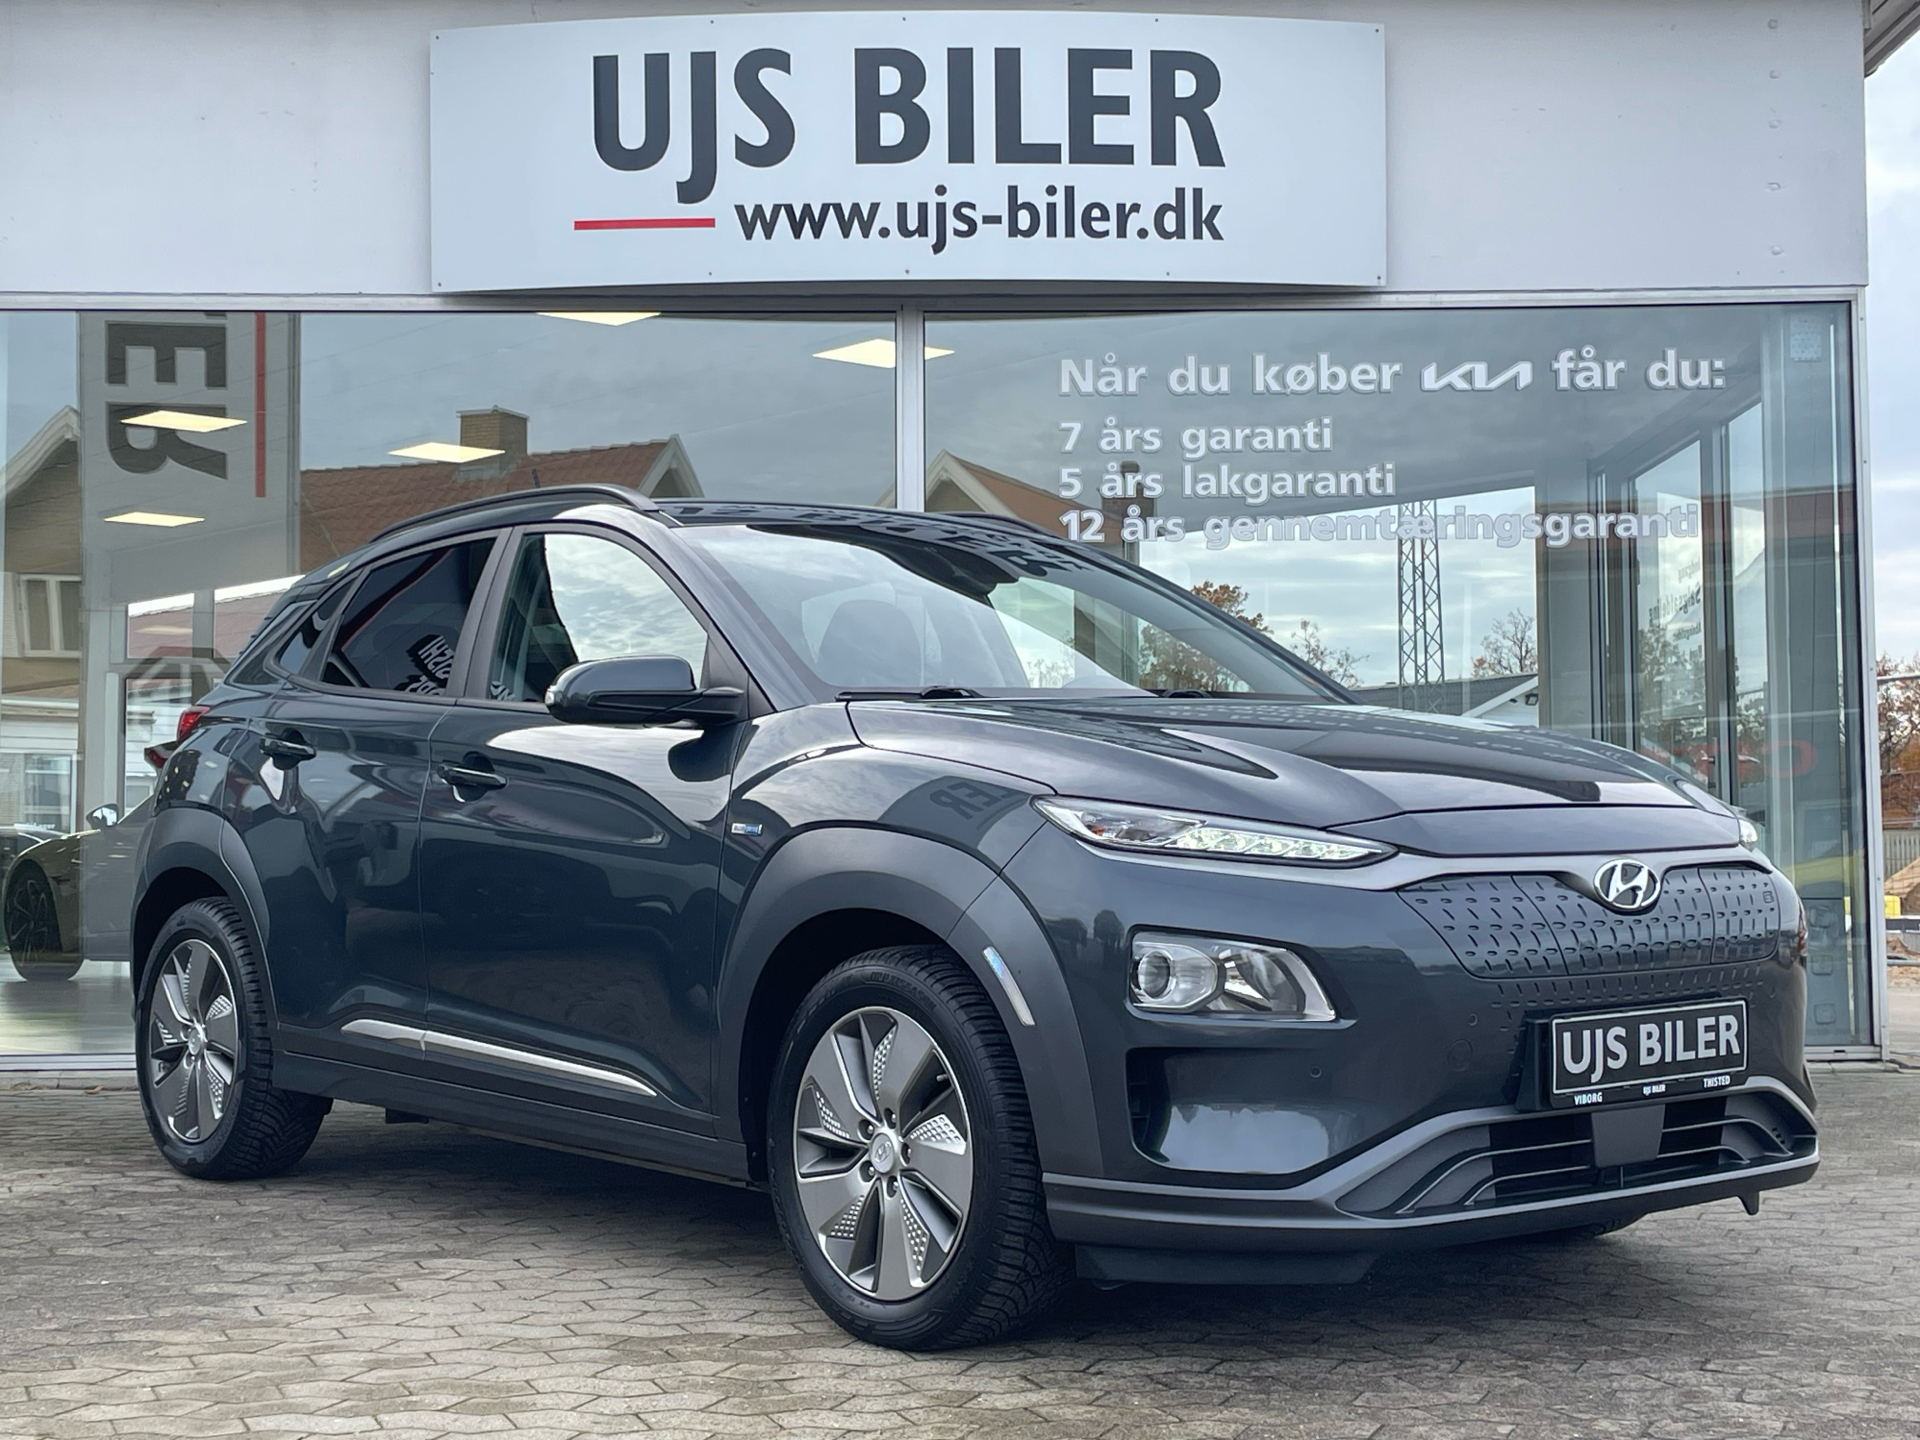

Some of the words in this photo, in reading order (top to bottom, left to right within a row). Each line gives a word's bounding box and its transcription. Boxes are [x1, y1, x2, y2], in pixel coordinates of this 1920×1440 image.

[593, 49, 796, 205] UJS
[854, 47, 1226, 167] BILER
[734, 185, 1224, 255] www.ujs-biler.dk
[1059, 352, 1147, 395] Når
[1167, 353, 1231, 395] du
[1253, 352, 1402, 395] køber
[1552, 345, 1626, 390] får
[1647, 347, 1725, 390] du:
[1059, 421, 1082, 452] 7
[1100, 415, 1162, 452] års
[1181, 416, 1332, 461] garanti
[1059, 466, 1082, 498] 5
[1101, 461, 1165, 498] års
[1183, 462, 1396, 506] lakgaranti
[1059, 509, 1105, 543] 12
[1121, 504, 1185, 543] års
[1204, 503, 1699, 550] gennemtæringsgaranti
[1562, 1026, 1628, 1083] UJS
[1638, 1014, 1741, 1066] BILER
[1574, 1092, 1603, 1105] VIBORG
